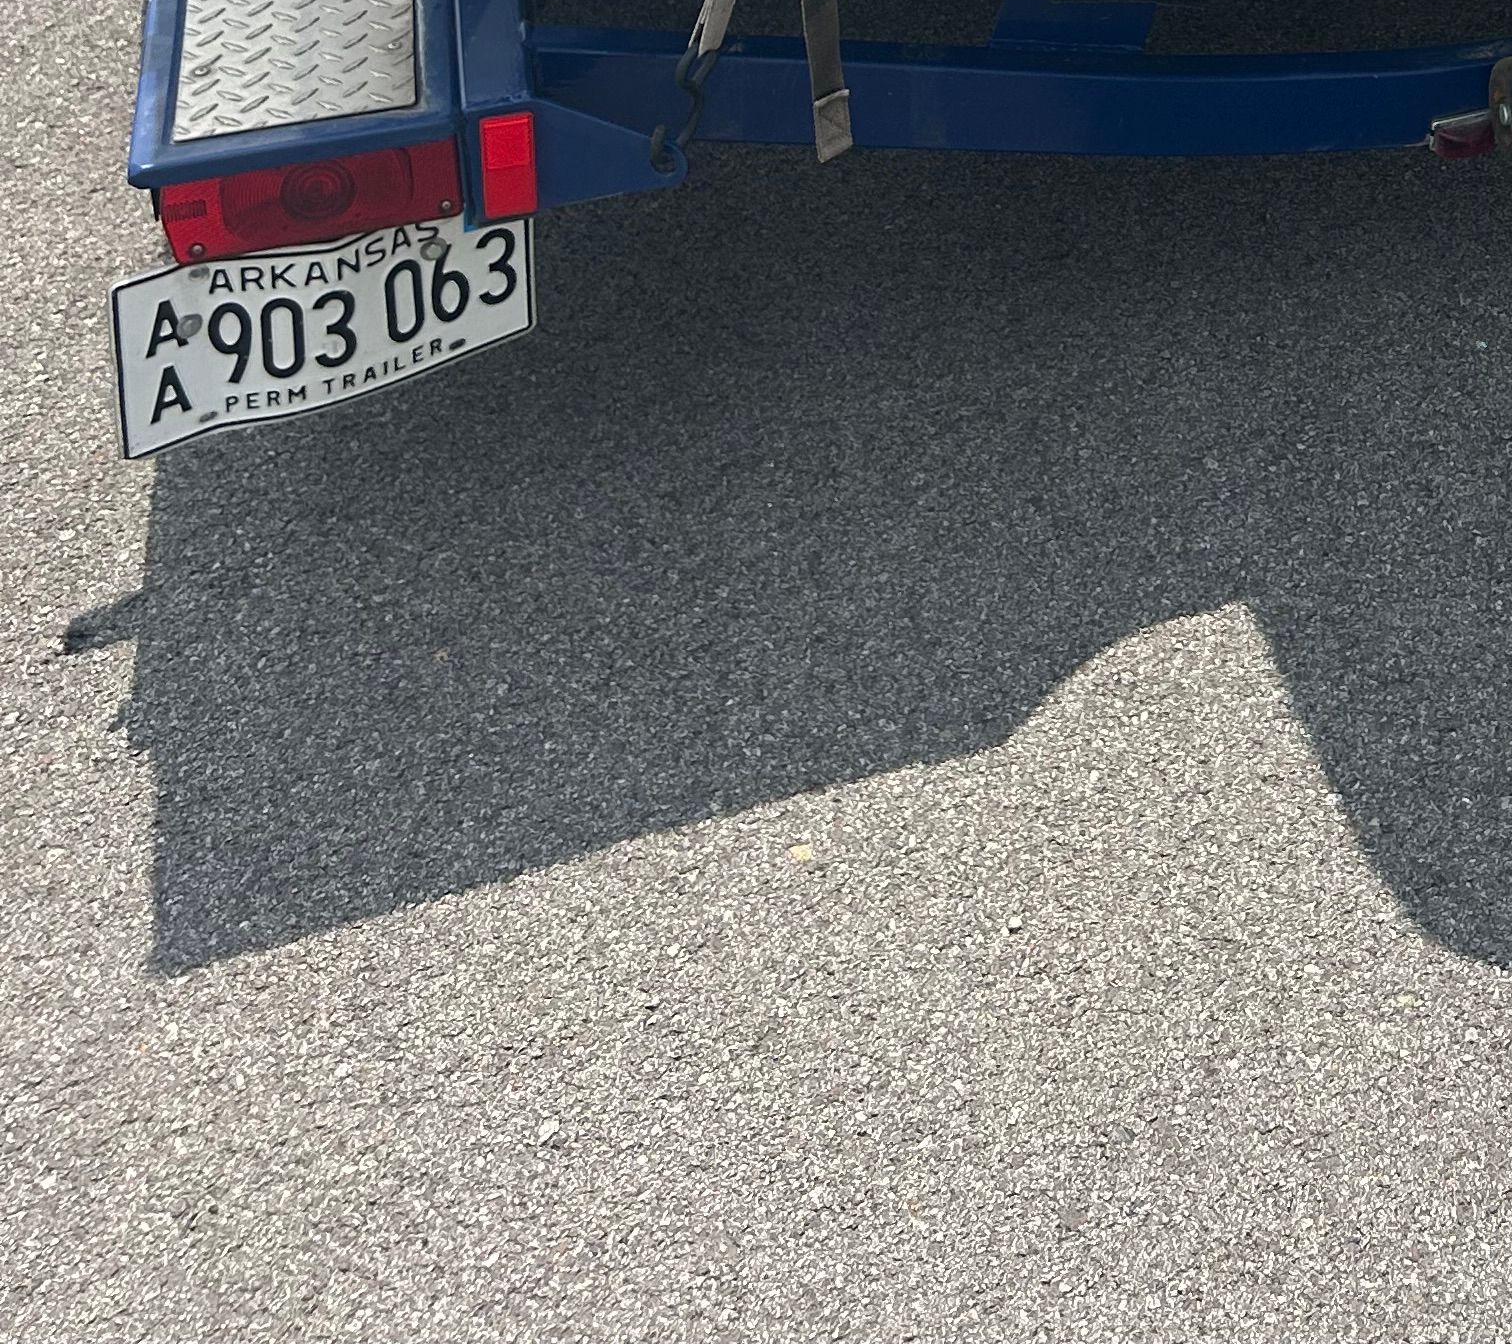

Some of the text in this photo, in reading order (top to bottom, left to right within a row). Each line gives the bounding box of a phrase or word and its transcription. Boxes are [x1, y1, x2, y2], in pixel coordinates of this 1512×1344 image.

[208, 223, 440, 295] ARKANSAS
[145, 228, 518, 384] A 903 063
[150, 365, 193, 424] A
[224, 338, 444, 413] PERM TRAILER
